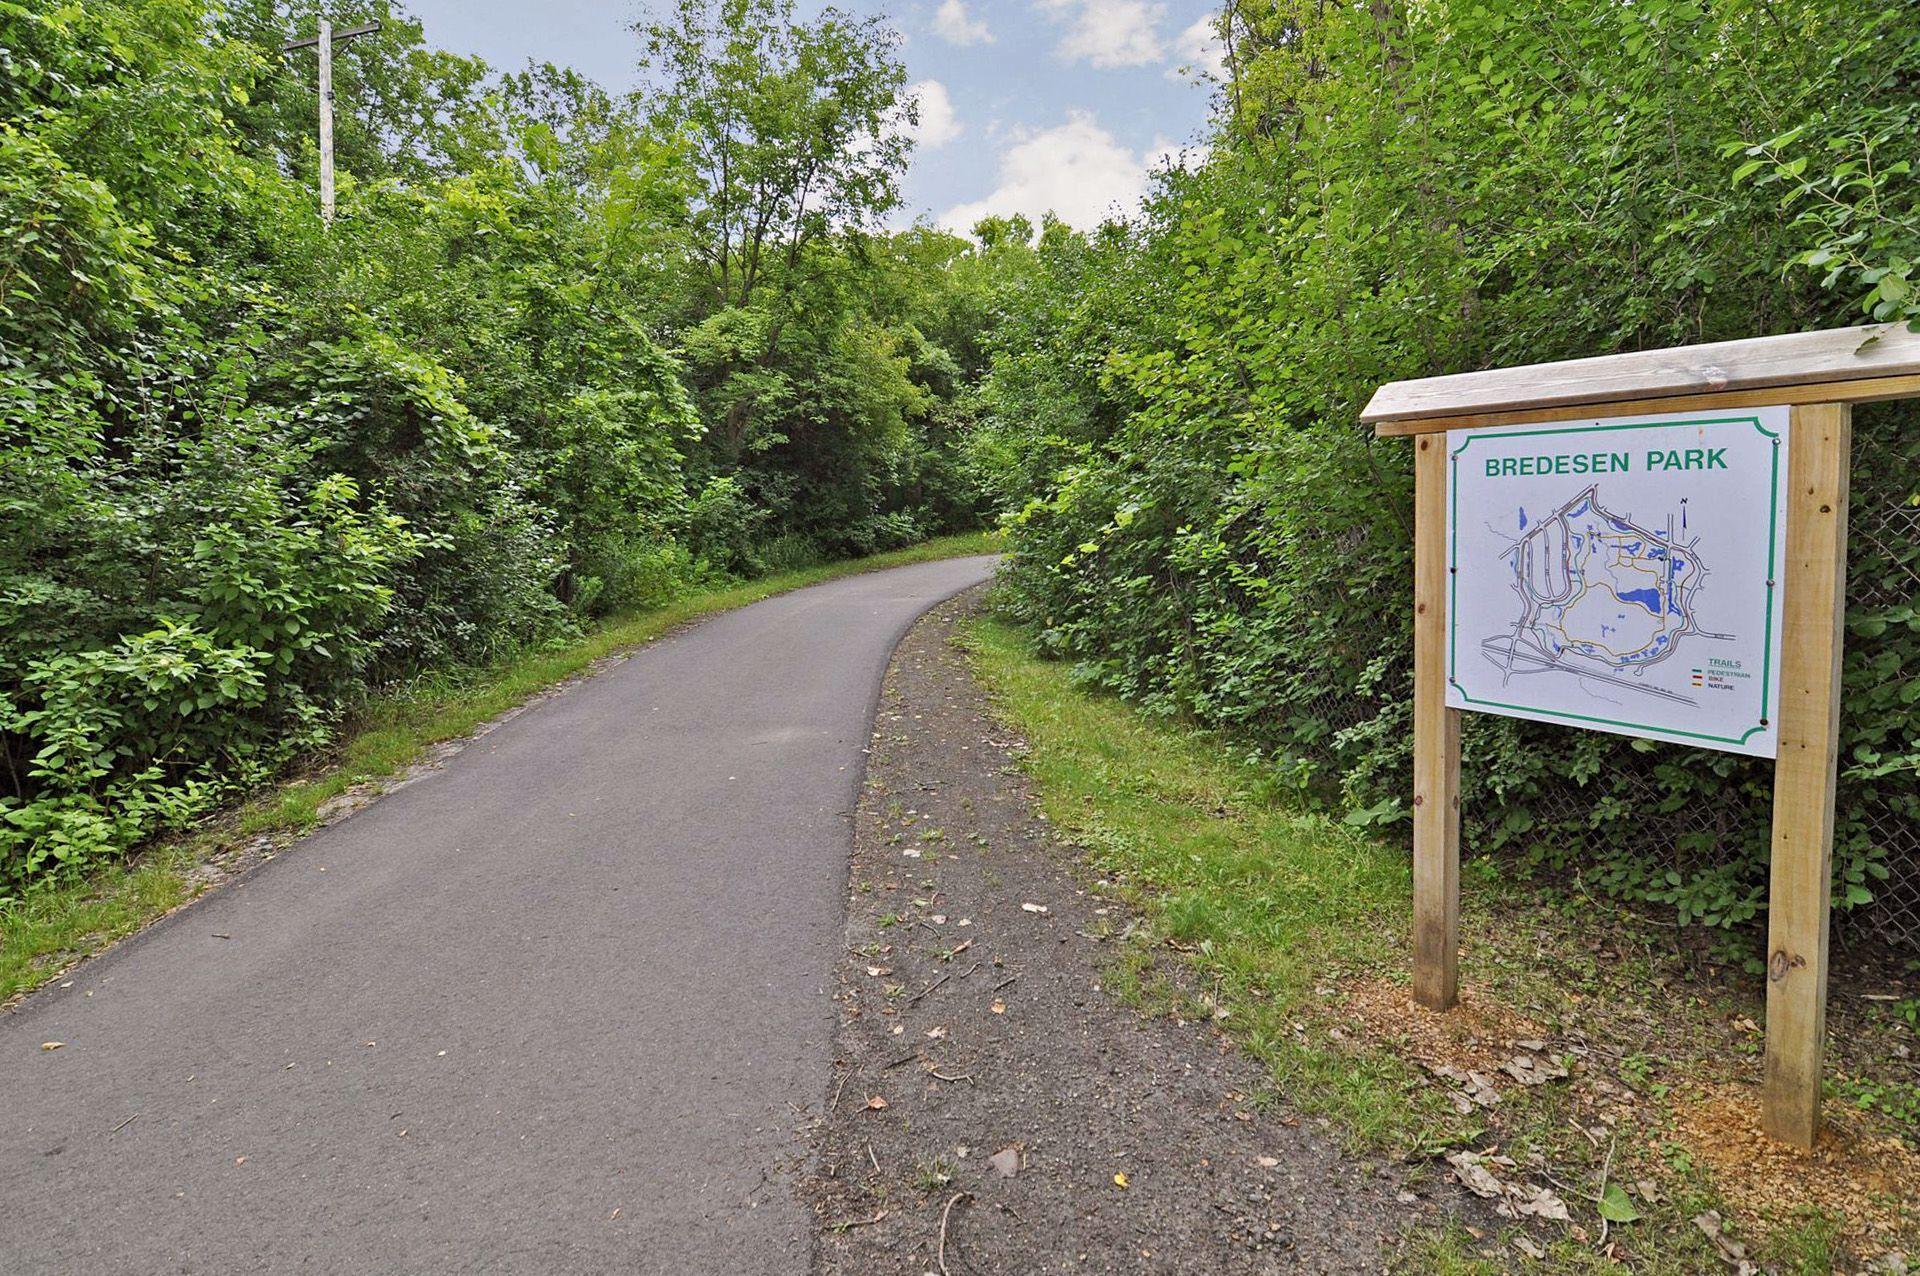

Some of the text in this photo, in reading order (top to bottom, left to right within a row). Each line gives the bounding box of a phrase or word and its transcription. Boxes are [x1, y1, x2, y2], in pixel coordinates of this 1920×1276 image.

[1485, 448, 1729, 477] BREDESEN PARK
[1680, 497, 1688, 505] N
[1708, 658, 1742, 669] TRAILS
[1707, 669, 1751, 679] PEDESTRIAN
[1708, 683, 1735, 691] NATURE
